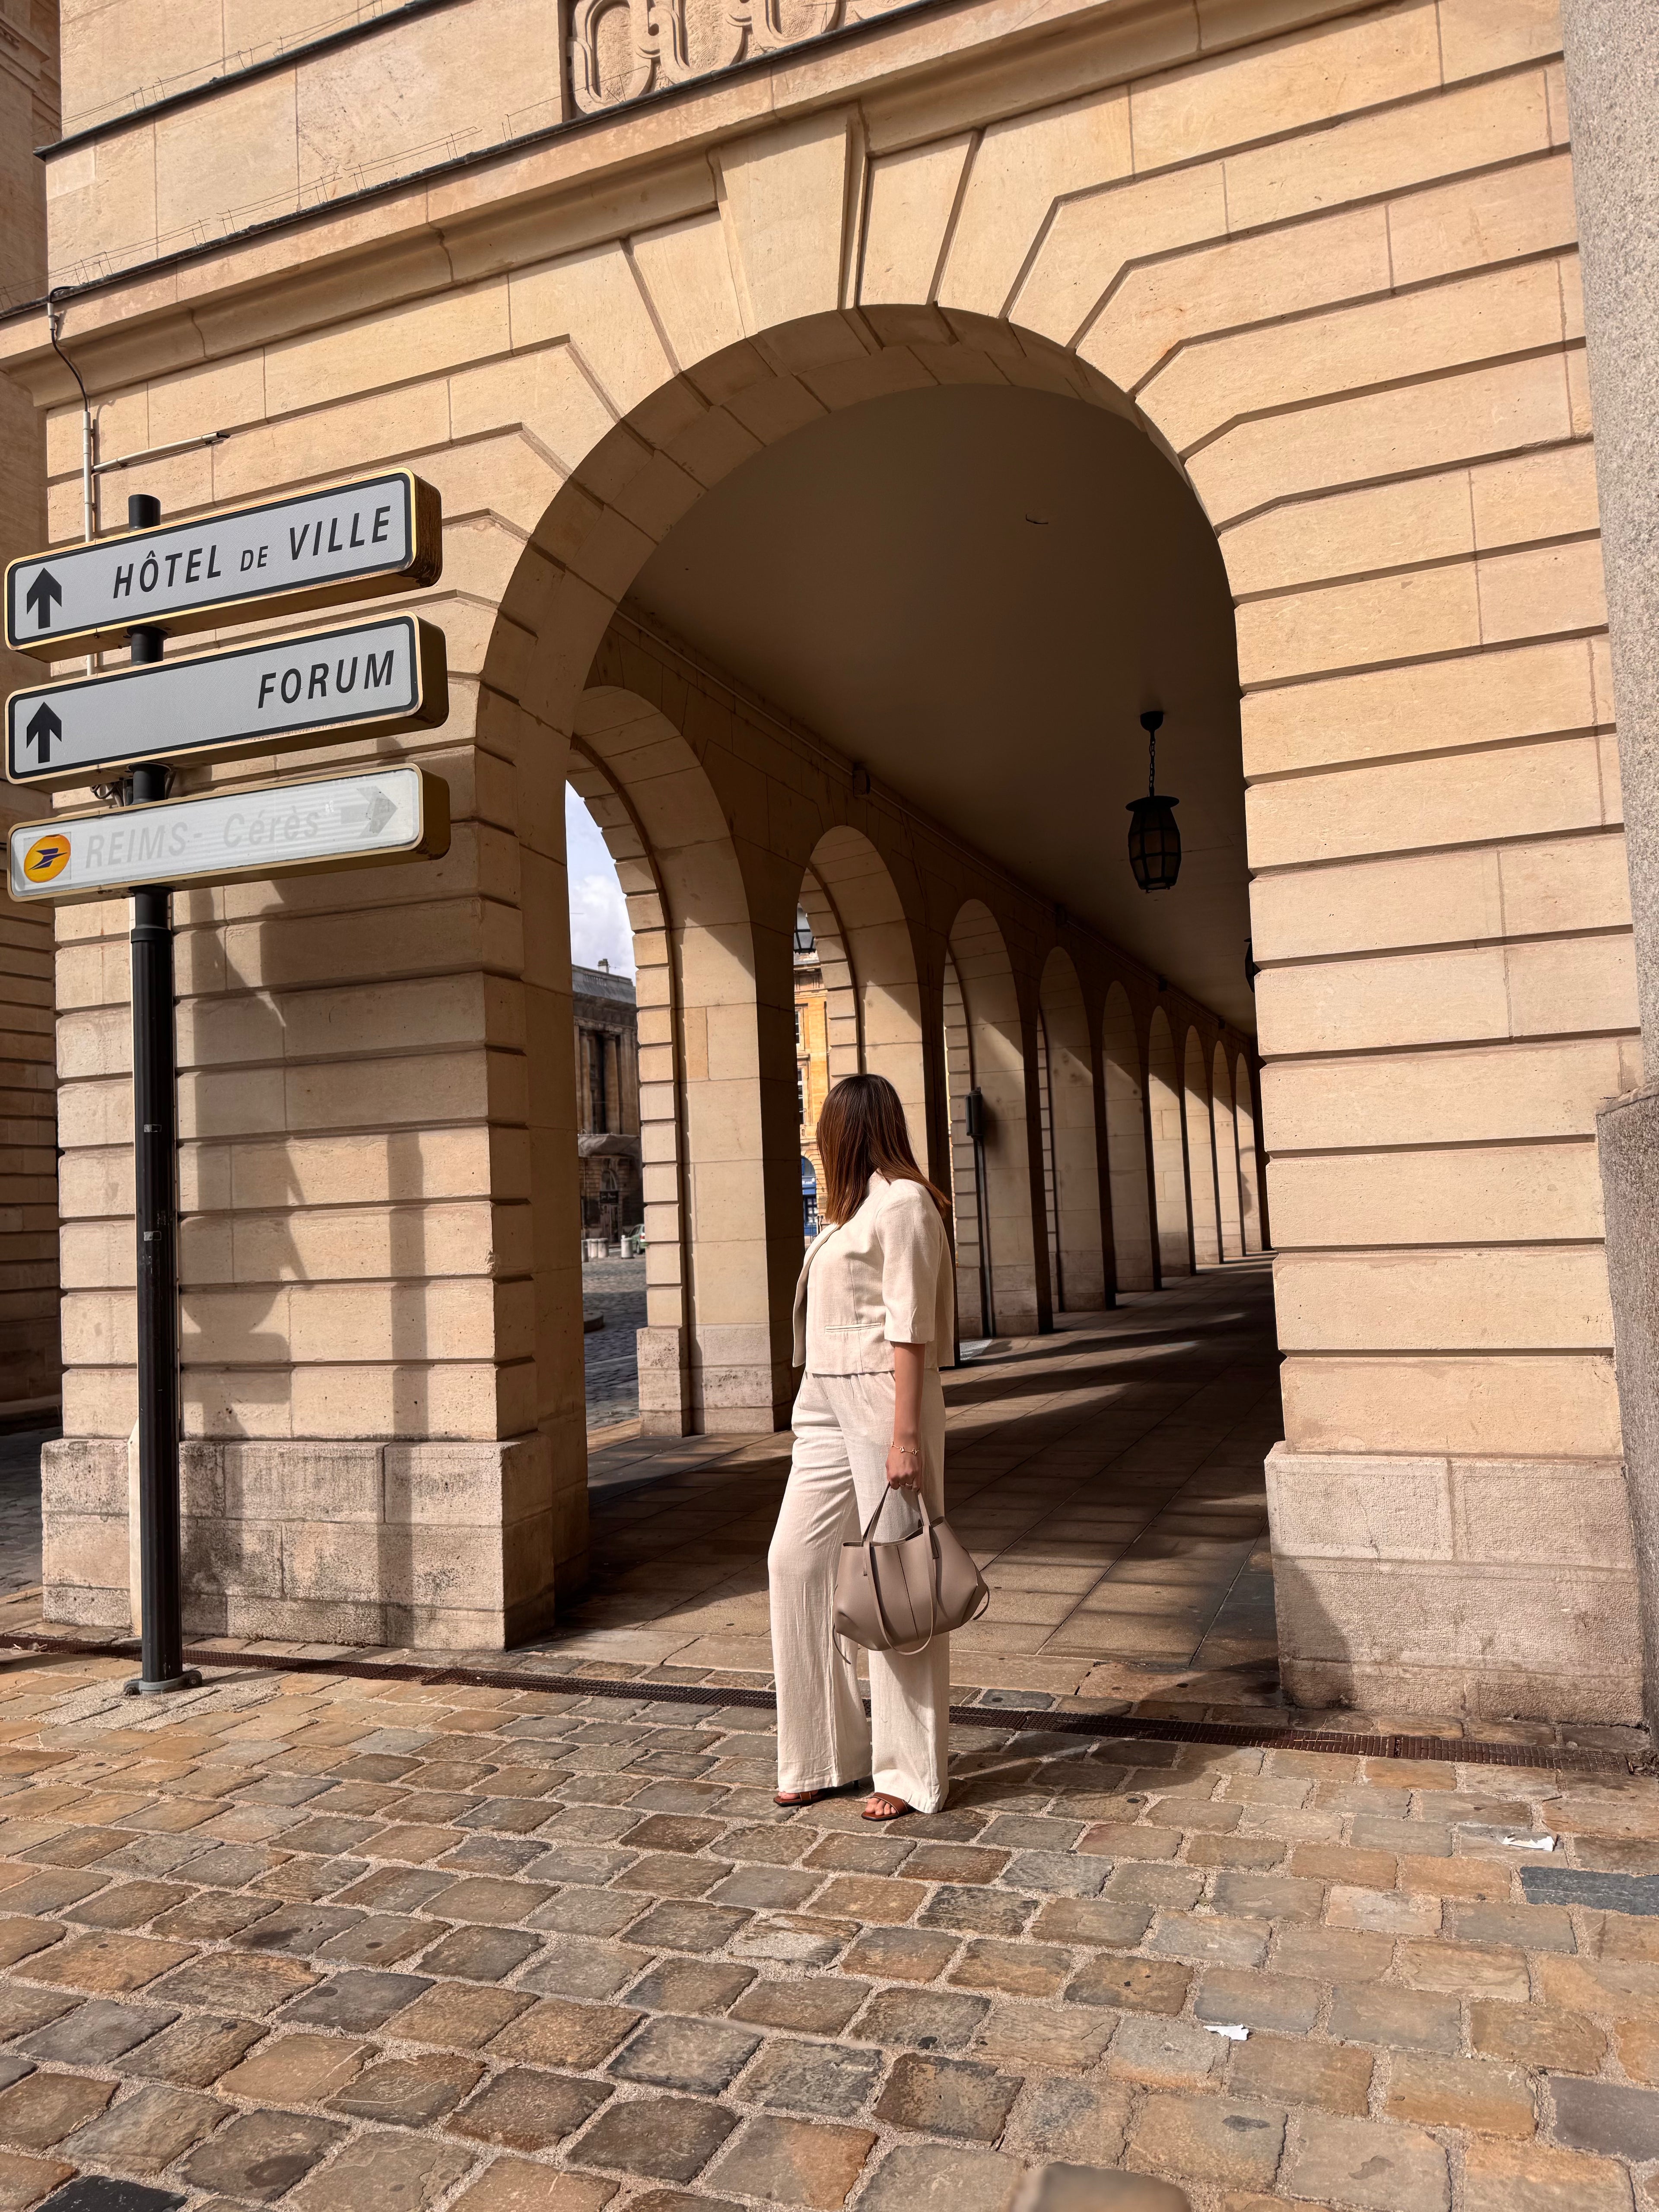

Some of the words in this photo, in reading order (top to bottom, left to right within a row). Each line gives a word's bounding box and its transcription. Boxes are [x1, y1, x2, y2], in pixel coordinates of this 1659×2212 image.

[113, 545, 221, 599] HÔTEL
[240, 545, 268, 572] DE
[289, 505, 391, 561] VILLE
[257, 649, 394, 709] FORUM
[223, 805, 319, 848] Cérès
